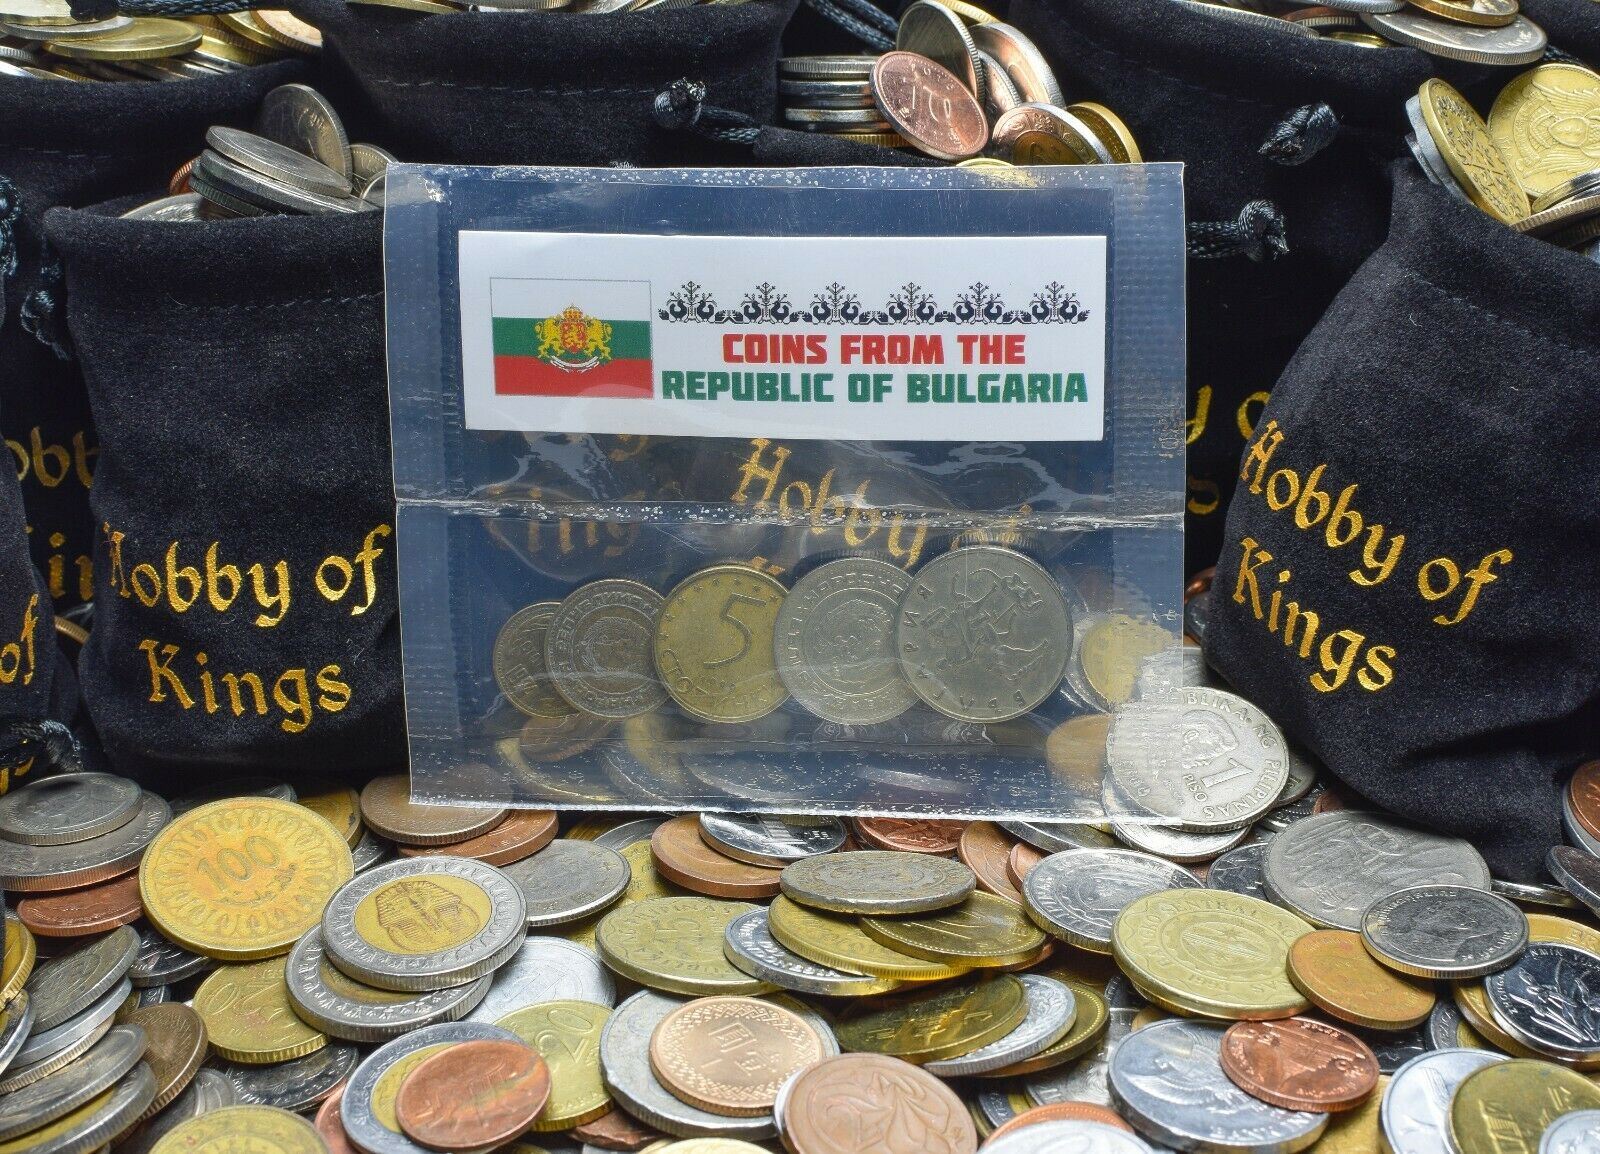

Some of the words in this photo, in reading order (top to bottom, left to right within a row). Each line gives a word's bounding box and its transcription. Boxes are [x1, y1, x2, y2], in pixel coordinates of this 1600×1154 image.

[661, 370, 834, 403] REPUBLIC
[847, 372, 893, 403] OF
[907, 372, 1089, 403] BULGARIA
[722, 333, 827, 364] COINS
[840, 334, 944, 365] FROM
[957, 334, 1026, 365] THE
[1241, 420, 1406, 586] Hobby
[1417, 549, 1514, 626] of
[315, 523, 391, 616] of
[703, 592, 767, 670] 5
[1231, 537, 1397, 693] Kings
[138, 638, 353, 733] Kings
[197, 835, 281, 896] 100
